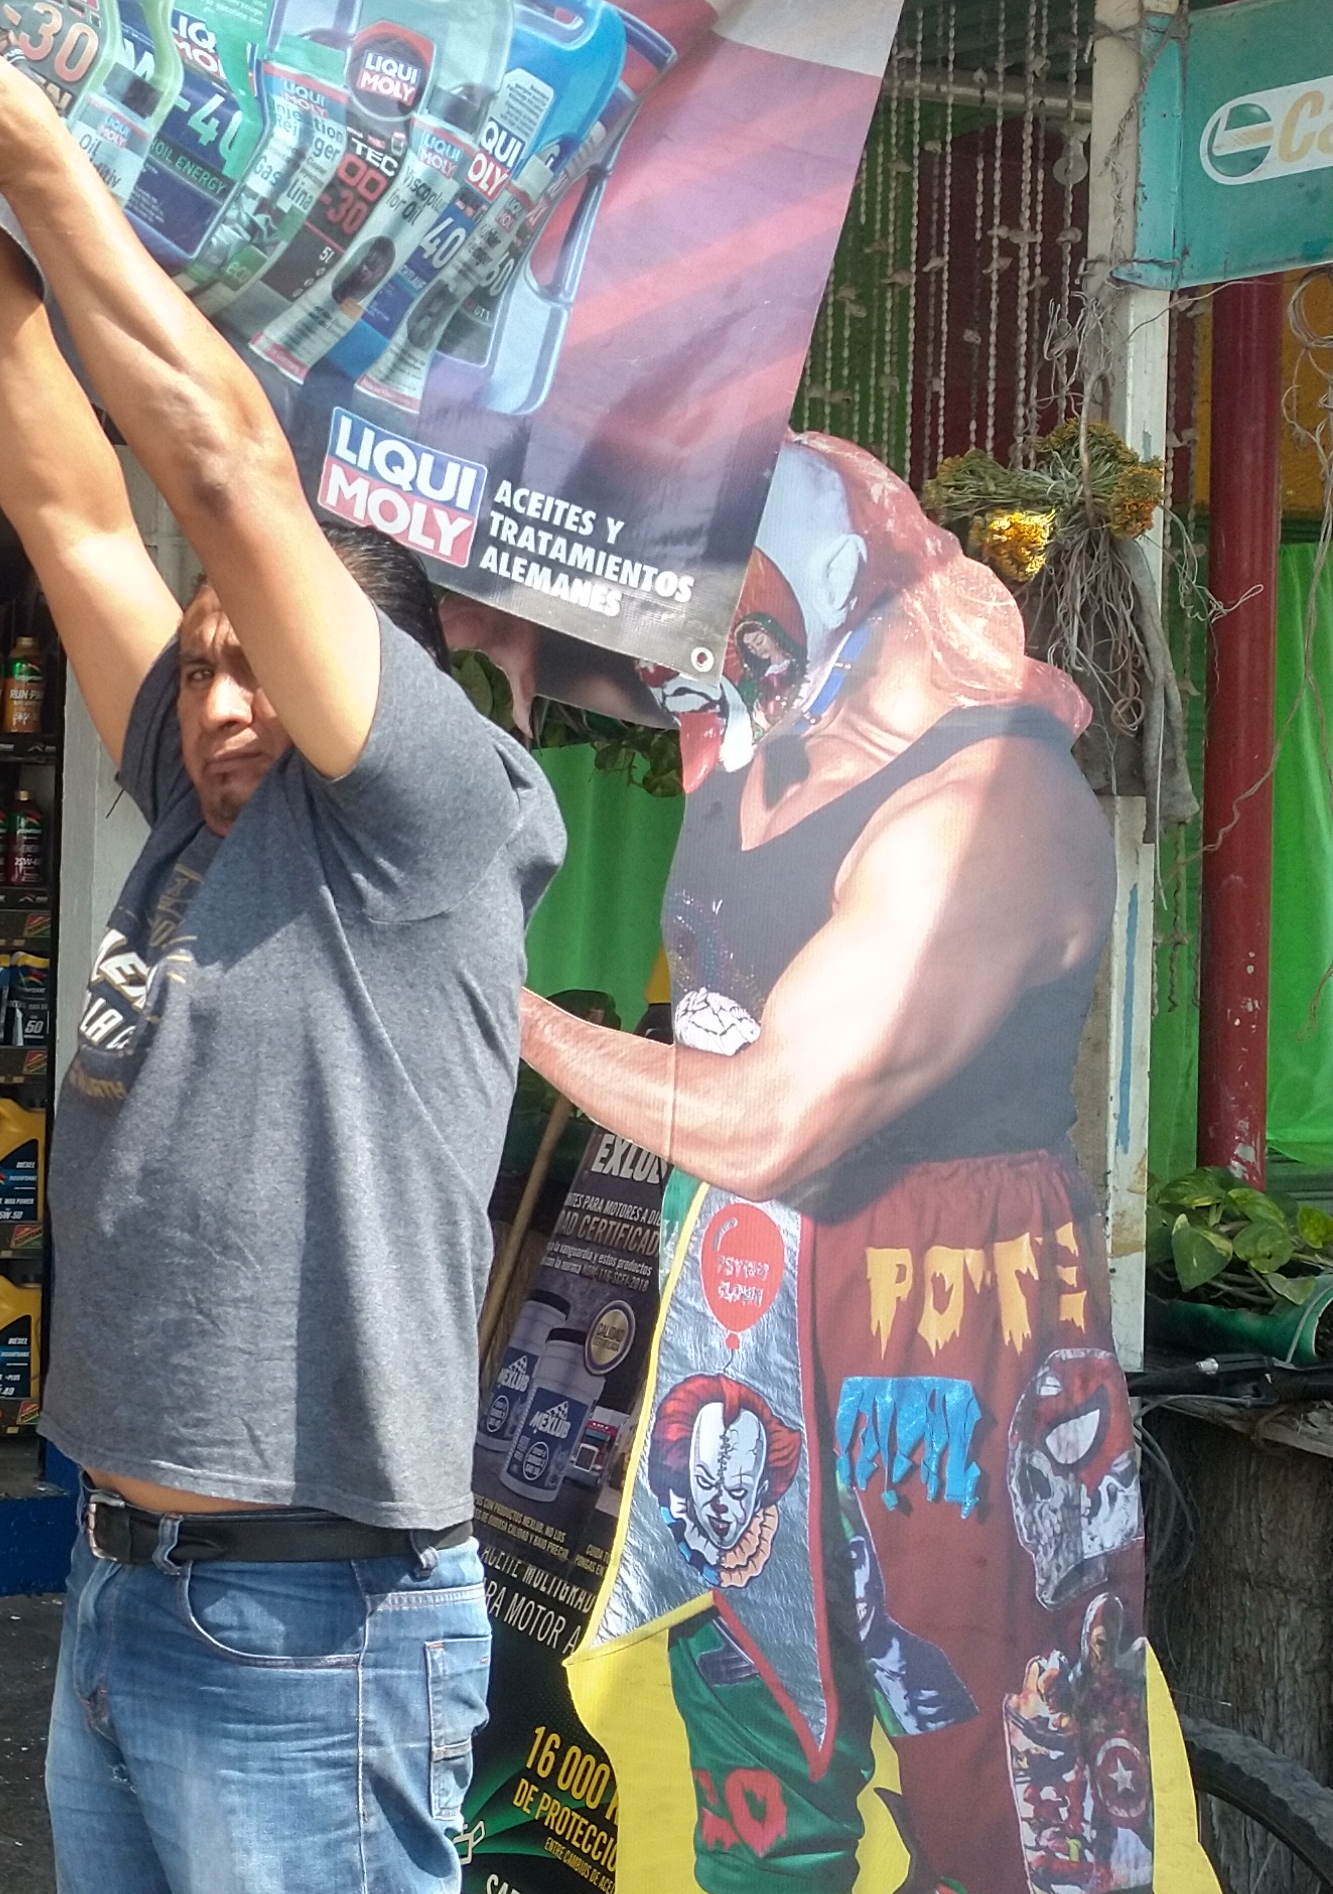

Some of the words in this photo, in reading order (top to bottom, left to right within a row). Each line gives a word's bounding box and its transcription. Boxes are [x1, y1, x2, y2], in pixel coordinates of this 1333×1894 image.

[364, 52, 419, 81] LIQUI
[284, 80, 326, 106] LIQUI
[359, 71, 416, 103] MOLY
[282, 91, 329, 118] MOLY
[98, 127, 127, 148] MOLY
[106, 115, 130, 136] LIQUI
[80, 134, 101, 155] Oil
[351, 136, 399, 177] TEC
[423, 133, 462, 161] LIQUI
[176, 155, 226, 195] ENERGY
[419, 148, 458, 178] MOLY
[402, 201, 423, 225] Oil
[419, 216, 466, 269] 40
[334, 416, 477, 510] LIQUI
[325, 464, 472, 557] MOLY
[494, 480, 596, 536] ACEITES
[607, 518, 625, 544] Y
[490, 510, 694, 602] TRATAMIENTOS
[480, 551, 623, 617] ALEMANES
[25, 1020, 44, 1034] 50
[583, 1195, 604, 1213] PARA
[603, 1199, 641, 1223] MOTORES
[559, 1243, 594, 1261] vanguardia
[598, 1252, 616, 1266] estos
[616, 1258, 653, 1276] productos
[561, 1260, 582, 1273] norma
[497, 1366, 530, 1393] MEXLUB
[529, 1411, 571, 1439] MEXLUB
[493, 1501, 523, 1523] PRODUCTOS
[507, 1522, 529, 1541] CALIDAD
[533, 1536, 548, 1549] BAJO
[481, 1544, 522, 1579] ACEITE
[504, 1593, 567, 1650] MOTOR
[562, 1625, 582, 1654] A
[526, 1725, 561, 1779] 16
[557, 1745, 611, 1810] 000
[513, 1777, 539, 1814] DE
[544, 1836, 566, 1860] ENTRE
[563, 1850, 590, 1880] CAMBIOS
[589, 1865, 601, 1886] DE
